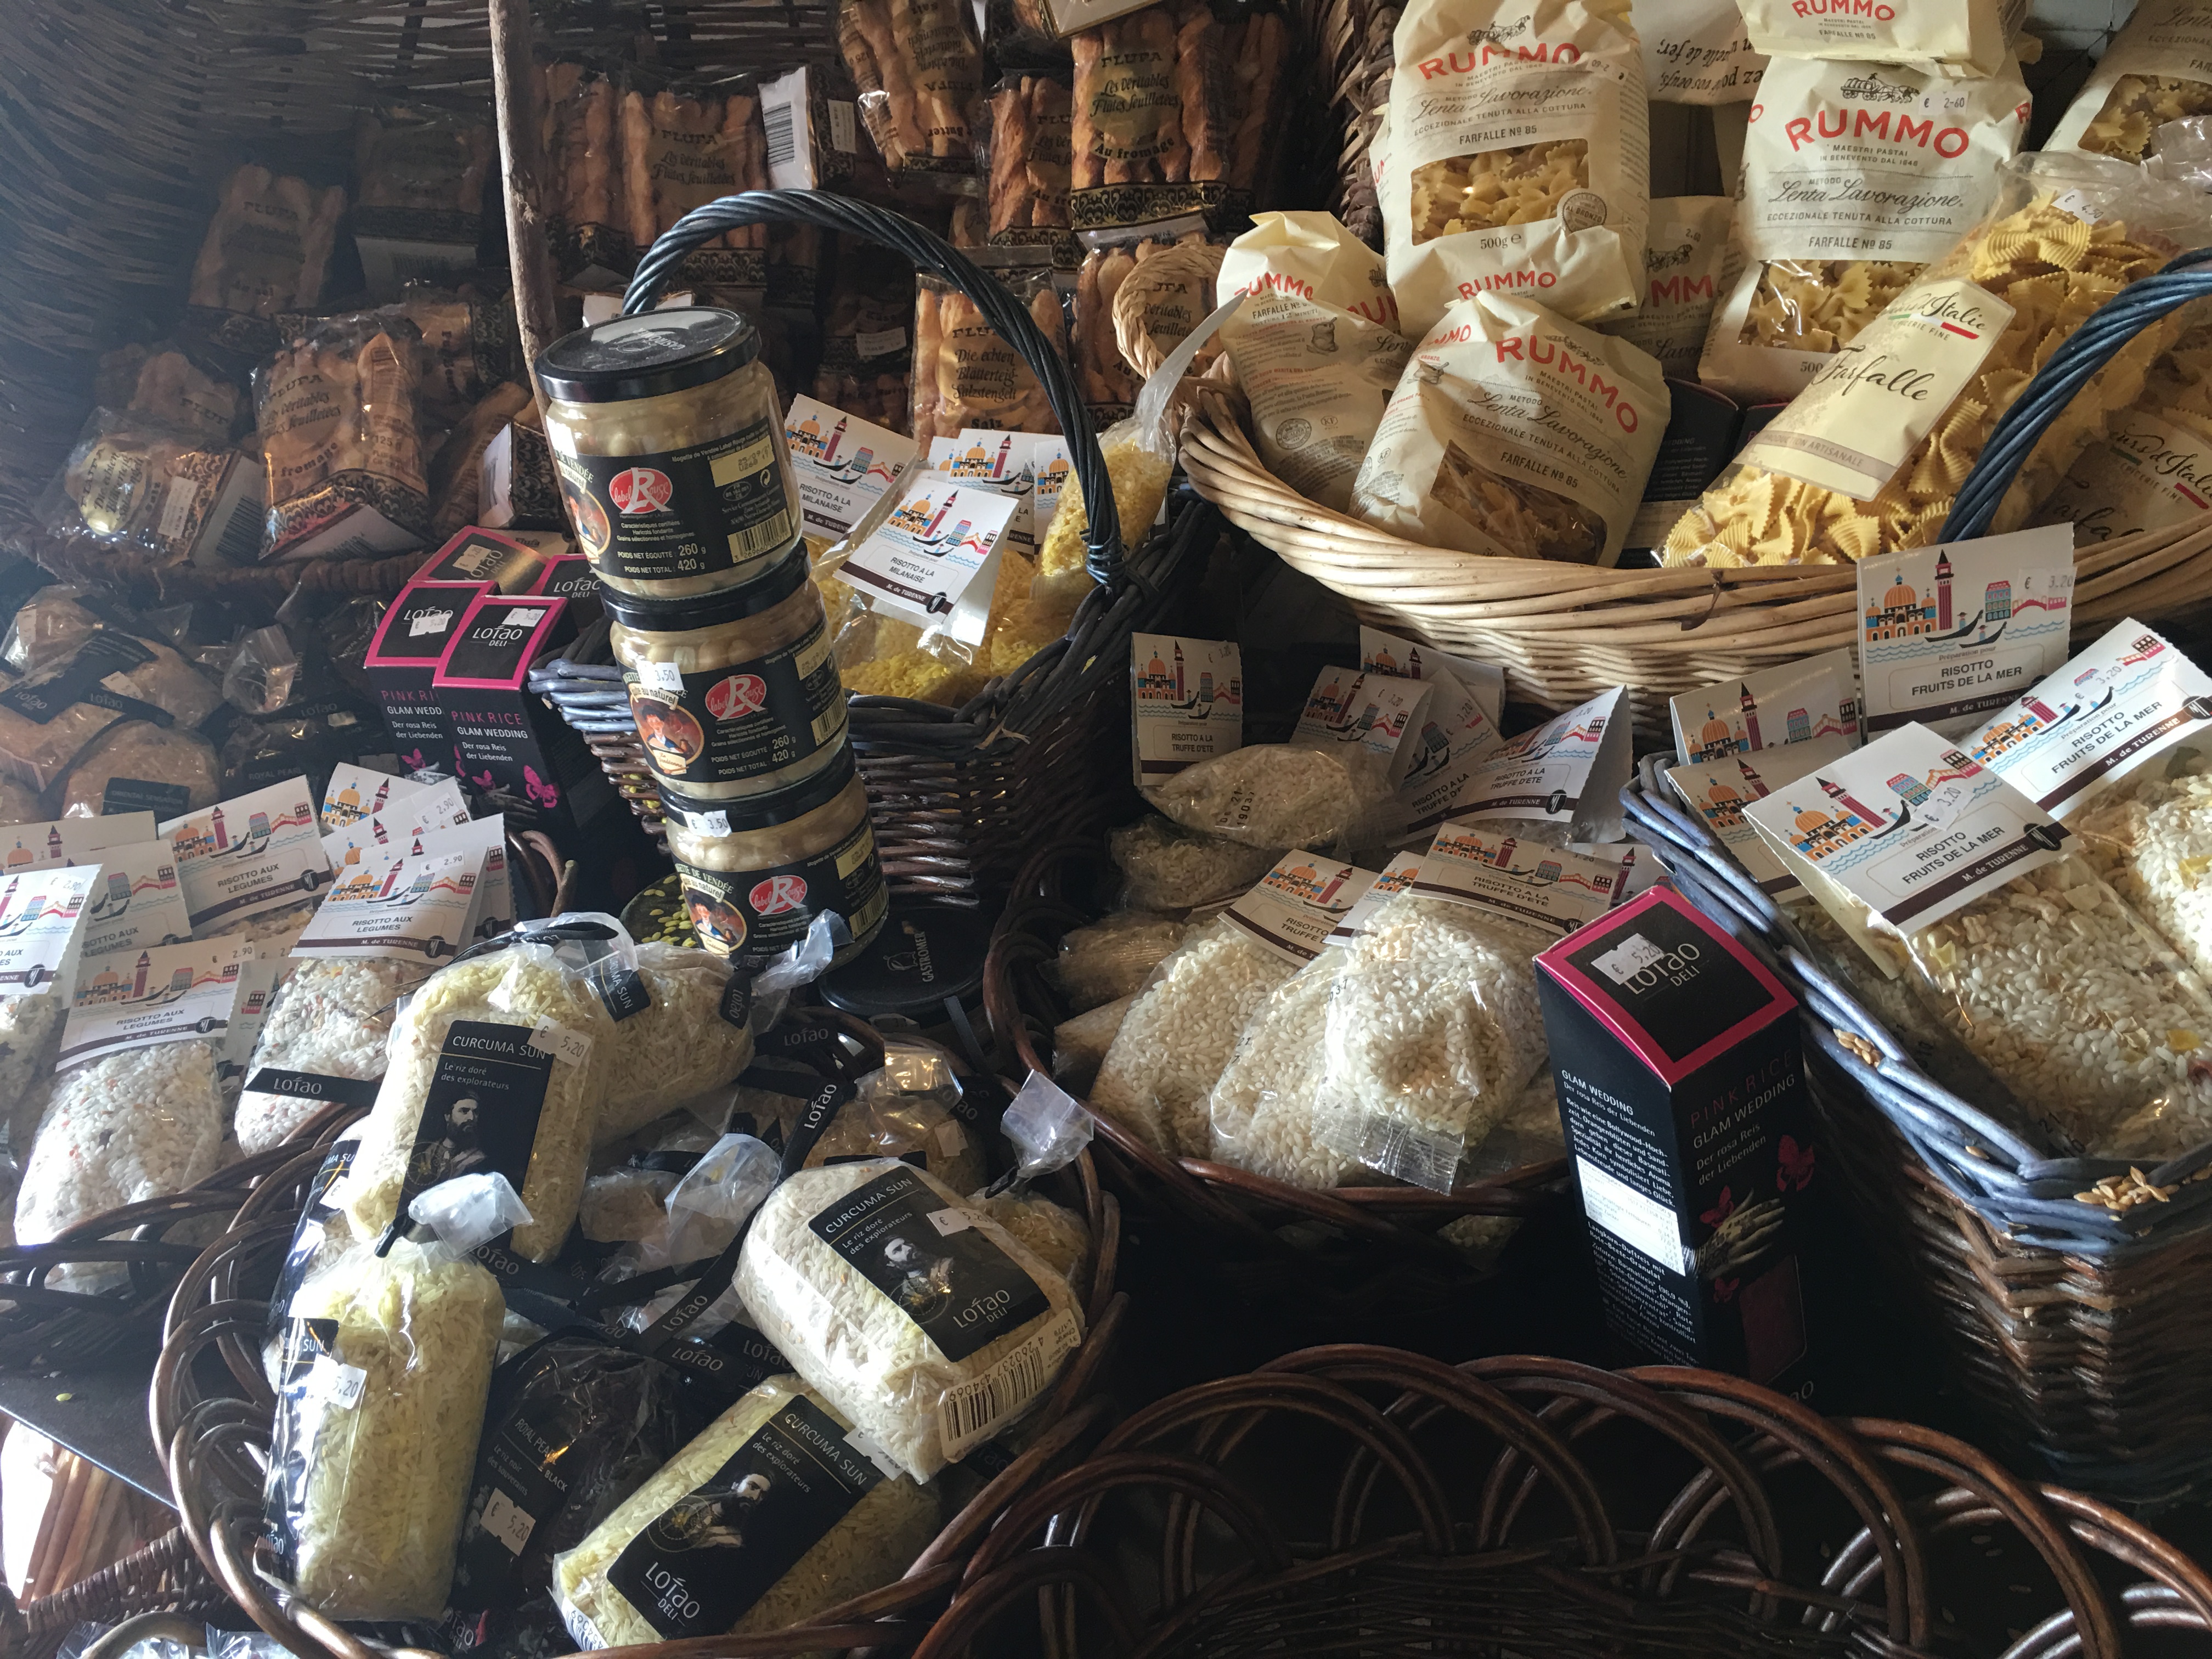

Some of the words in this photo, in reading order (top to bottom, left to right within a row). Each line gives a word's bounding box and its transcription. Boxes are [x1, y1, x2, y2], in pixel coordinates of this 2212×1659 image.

[1792, 0, 1895, 21] RUMMO
[1418, 42, 1581, 80] RUMMO
[1414, 116, 1474, 136] ECCEZIONALE
[1476, 108, 1513, 120] TENUTA
[1516, 106, 1539, 115] ALLA
[1542, 103, 1586, 114] COTTURA
[1459, 129, 1506, 145] FARFALLE
[1525, 125, 1537, 134] 85
[1785, 109, 1970, 159] RUMMO
[1095, 142, 1113, 158] Au
[1116, 136, 1175, 160] fromage
[1833, 144, 1873, 155] MAESTRI
[1877, 148, 1908, 156] PASTAI
[1768, 180, 1825, 202] Lenta
[1809, 177, 1841, 185] METODO
[1767, 212, 1828, 221] ECCEZIONALE
[1832, 212, 1871, 222] TENUTA
[1874, 216, 1900, 225] ALLA
[1904, 217, 1953, 225] COTTURA
[1809, 236, 1859, 249] FARFALLE
[1878, 239, 1892, 250] 85
[1458, 271, 1556, 301] RUMMO
[1929, 328, 1950, 341] FINE
[956, 349, 975, 363] Die
[1811, 345, 1935, 401] Farfalle
[1497, 335, 1639, 433] RUMMO
[1467, 391, 1528, 419] Lenta
[1509, 394, 1543, 406] METODO
[1463, 414, 1526, 439] ECCEZIONALE
[1529, 433, 1565, 455] TENUTA
[1566, 450, 1587, 467] ALLA
[1588, 466, 1620, 493] COTTURA
[1809, 441, 1864, 467] ARTISANALE
[1500, 452, 1549, 476] FARFALLE
[1566, 473, 1579, 488] 85
[678, 543, 698, 556] 260
[678, 558, 697, 571] 420
[889, 566, 926, 583] MILANAISE
[890, 557, 919, 572] RISOTTO
[1941, 659, 1994, 679] RISOTTO
[1911, 676, 1954, 696] FRUITS
[1957, 675, 1974, 687] DE
[1978, 672, 1993, 683] LA
[1996, 666, 2023, 679] MER
[452, 711, 483, 723] PINK
[489, 713, 523, 725] RICE
[457, 727, 482, 737] GLAM
[484, 728, 528, 740] WEDDING
[1171, 732, 1198, 743] RISOTTO
[2051, 744, 2095, 774] FRUITS
[2096, 730, 2115, 744] DE
[2117, 721, 2131, 733] LA
[2132, 701, 2163, 724] MER
[2071, 712, 2125, 748] RISOTTO
[1172, 743, 1194, 752] TRUFFE
[2105, 757, 2119, 766] M.
[2119, 747, 2132, 757] de
[2132, 717, 2181, 747] TURENNE
[466, 752, 477, 760] der
[479, 752, 513, 762] Liebenden
[1491, 780, 1516, 789] TRUFFE
[1495, 770, 1526, 782] RISOTTO
[1902, 857, 1945, 884] FRUITS
[1943, 849, 1963, 862] DE
[1961, 840, 1979, 854] LA
[1977, 826, 2005, 844] MER
[1916, 832, 1966, 861] RISOTTO
[1961, 873, 1976, 882] M.
[1976, 866, 1988, 875] de
[1985, 844, 2029, 868] TURENNE
[352, 916, 392, 927] RISOTTO
[356, 923, 400, 933] LEGUMES
[382, 939, 418, 948] TURENNE
[1670, 966, 1701, 987] DELI
[452, 1035, 515, 1056] CURCUMA
[519, 1045, 546, 1060] SUN
[444, 1062, 454, 1072] Le
[455, 1064, 467, 1074] riz
[468, 1063, 487, 1075] doré
[441, 1073, 455, 1082] des
[457, 1075, 510, 1091] explorateurs
[1562, 1070, 1587, 1090] GLAM
[1589, 1084, 1634, 1115] WEDDING
[1564, 1081, 1575, 1093] Der
[1577, 1090, 1590, 1101] rosa
[1592, 1097, 1606, 1110] Reis
[1607, 1107, 1618, 1117] der
[1620, 1112, 1655, 1137] Liebenden
[1694, 1117, 1731, 1149] GLAM
[1734, 1073, 1795, 1124] WEDDING
[825, 1190, 886, 1234] CURCUMA
[886, 1177, 913, 1195] SUN
[842, 1237, 853, 1250] Le
[853, 1229, 865, 1242] riz
[863, 1217, 884, 1234] doré
[849, 1242, 864, 1255] des
[863, 1211, 913, 1244] explorateurs
[985, 1308, 1008, 1323] DELI
[784, 1412, 842, 1462] CURCUMA
[839, 1458, 867, 1486] SUN
[657, 1597, 679, 1621] DELI
